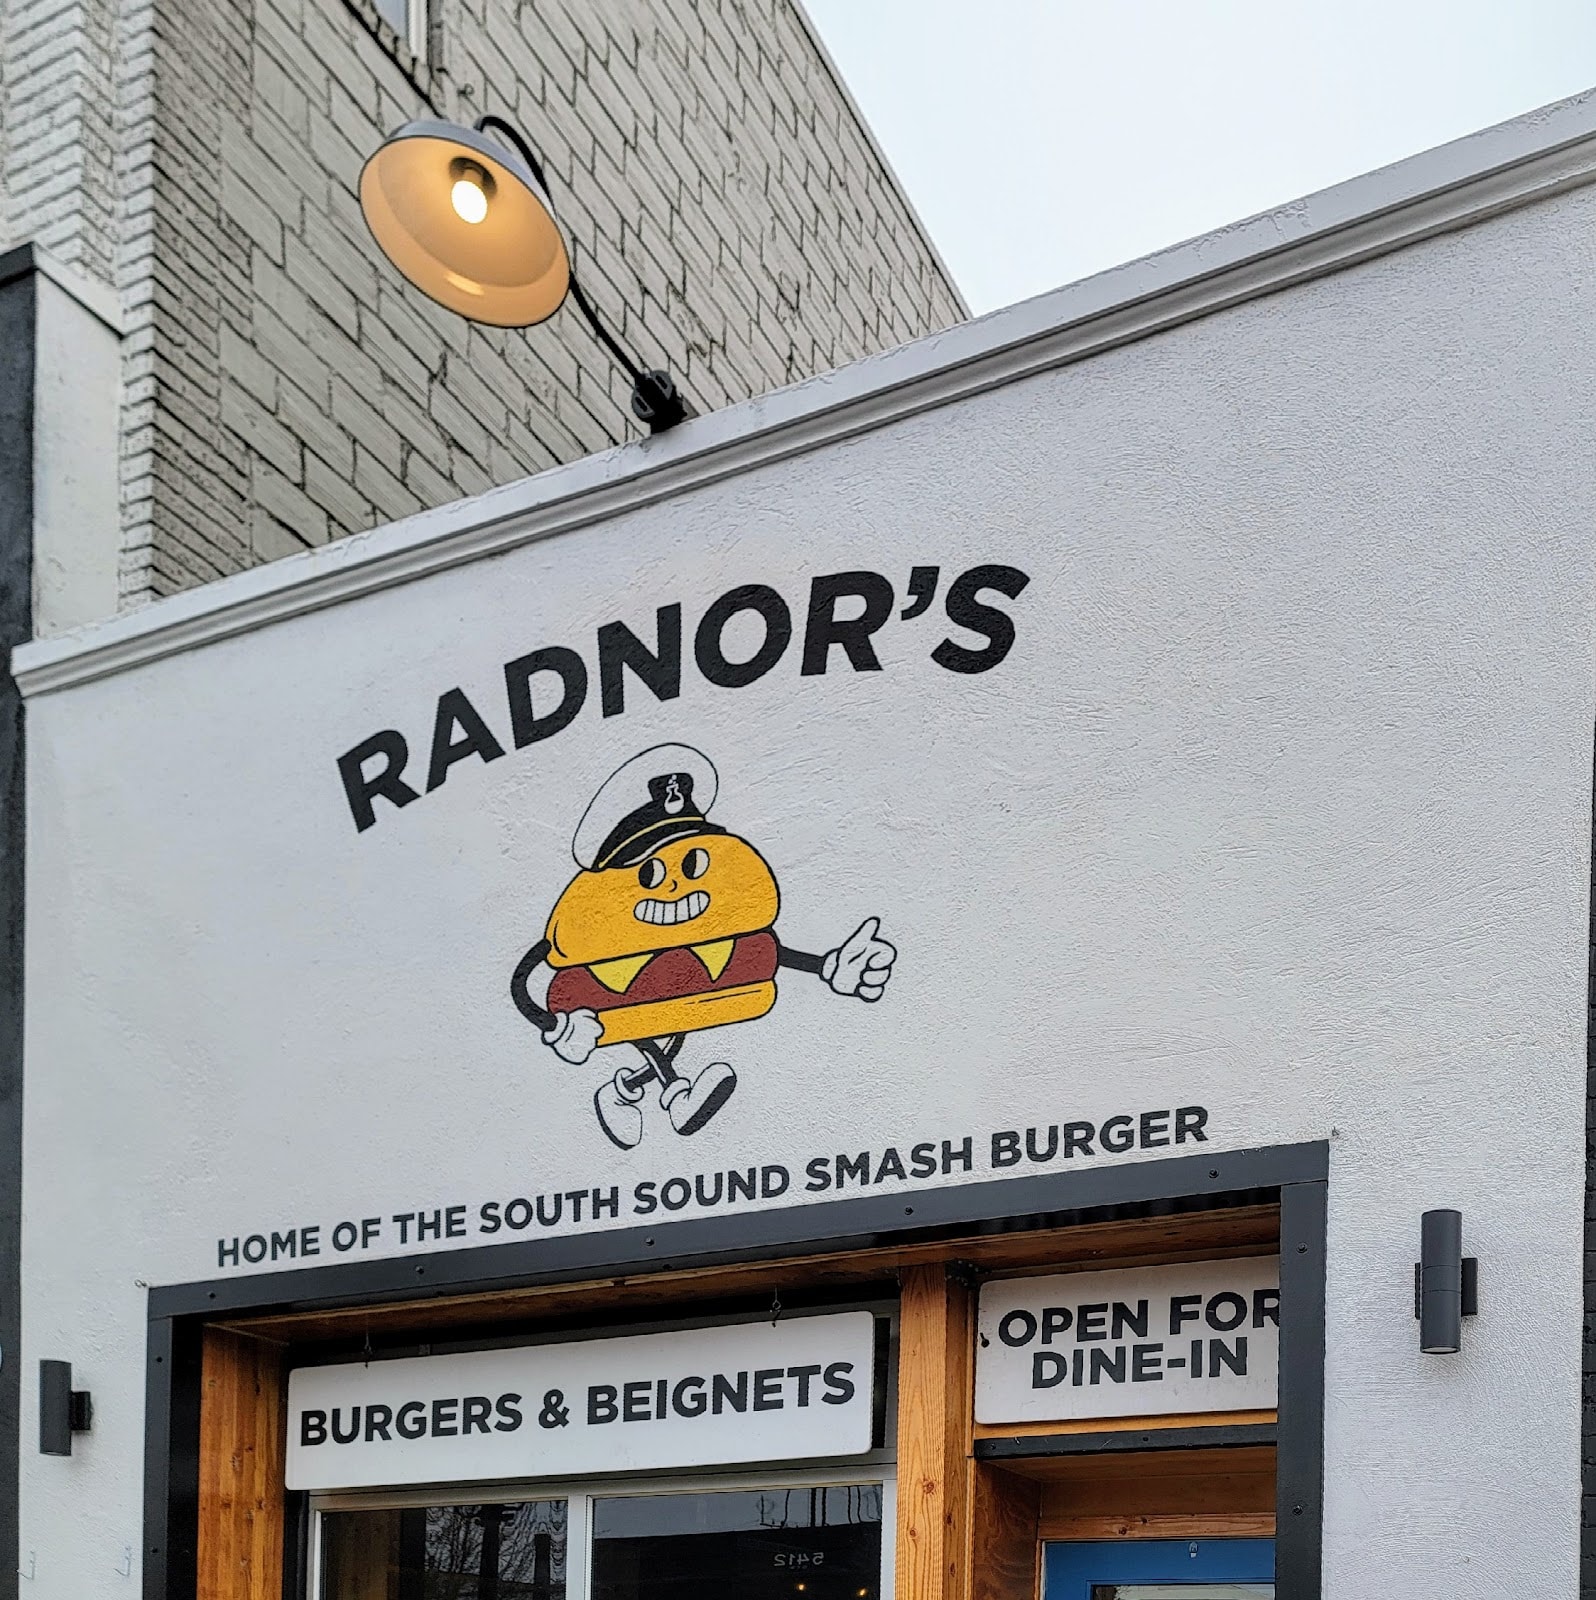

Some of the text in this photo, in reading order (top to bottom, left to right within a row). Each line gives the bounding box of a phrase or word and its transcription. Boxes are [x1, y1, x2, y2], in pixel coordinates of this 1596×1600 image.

[336, 564, 1031, 834] RADNOR'S
[218, 1105, 1209, 1268] HOME OF THE SOUTH SOUND SMASH BURGER
[998, 1288, 1279, 1348] OPEN FOR
[300, 1361, 856, 1447] BURGERS & BEIGNETS
[1031, 1336, 1248, 1390] DINE-IN
